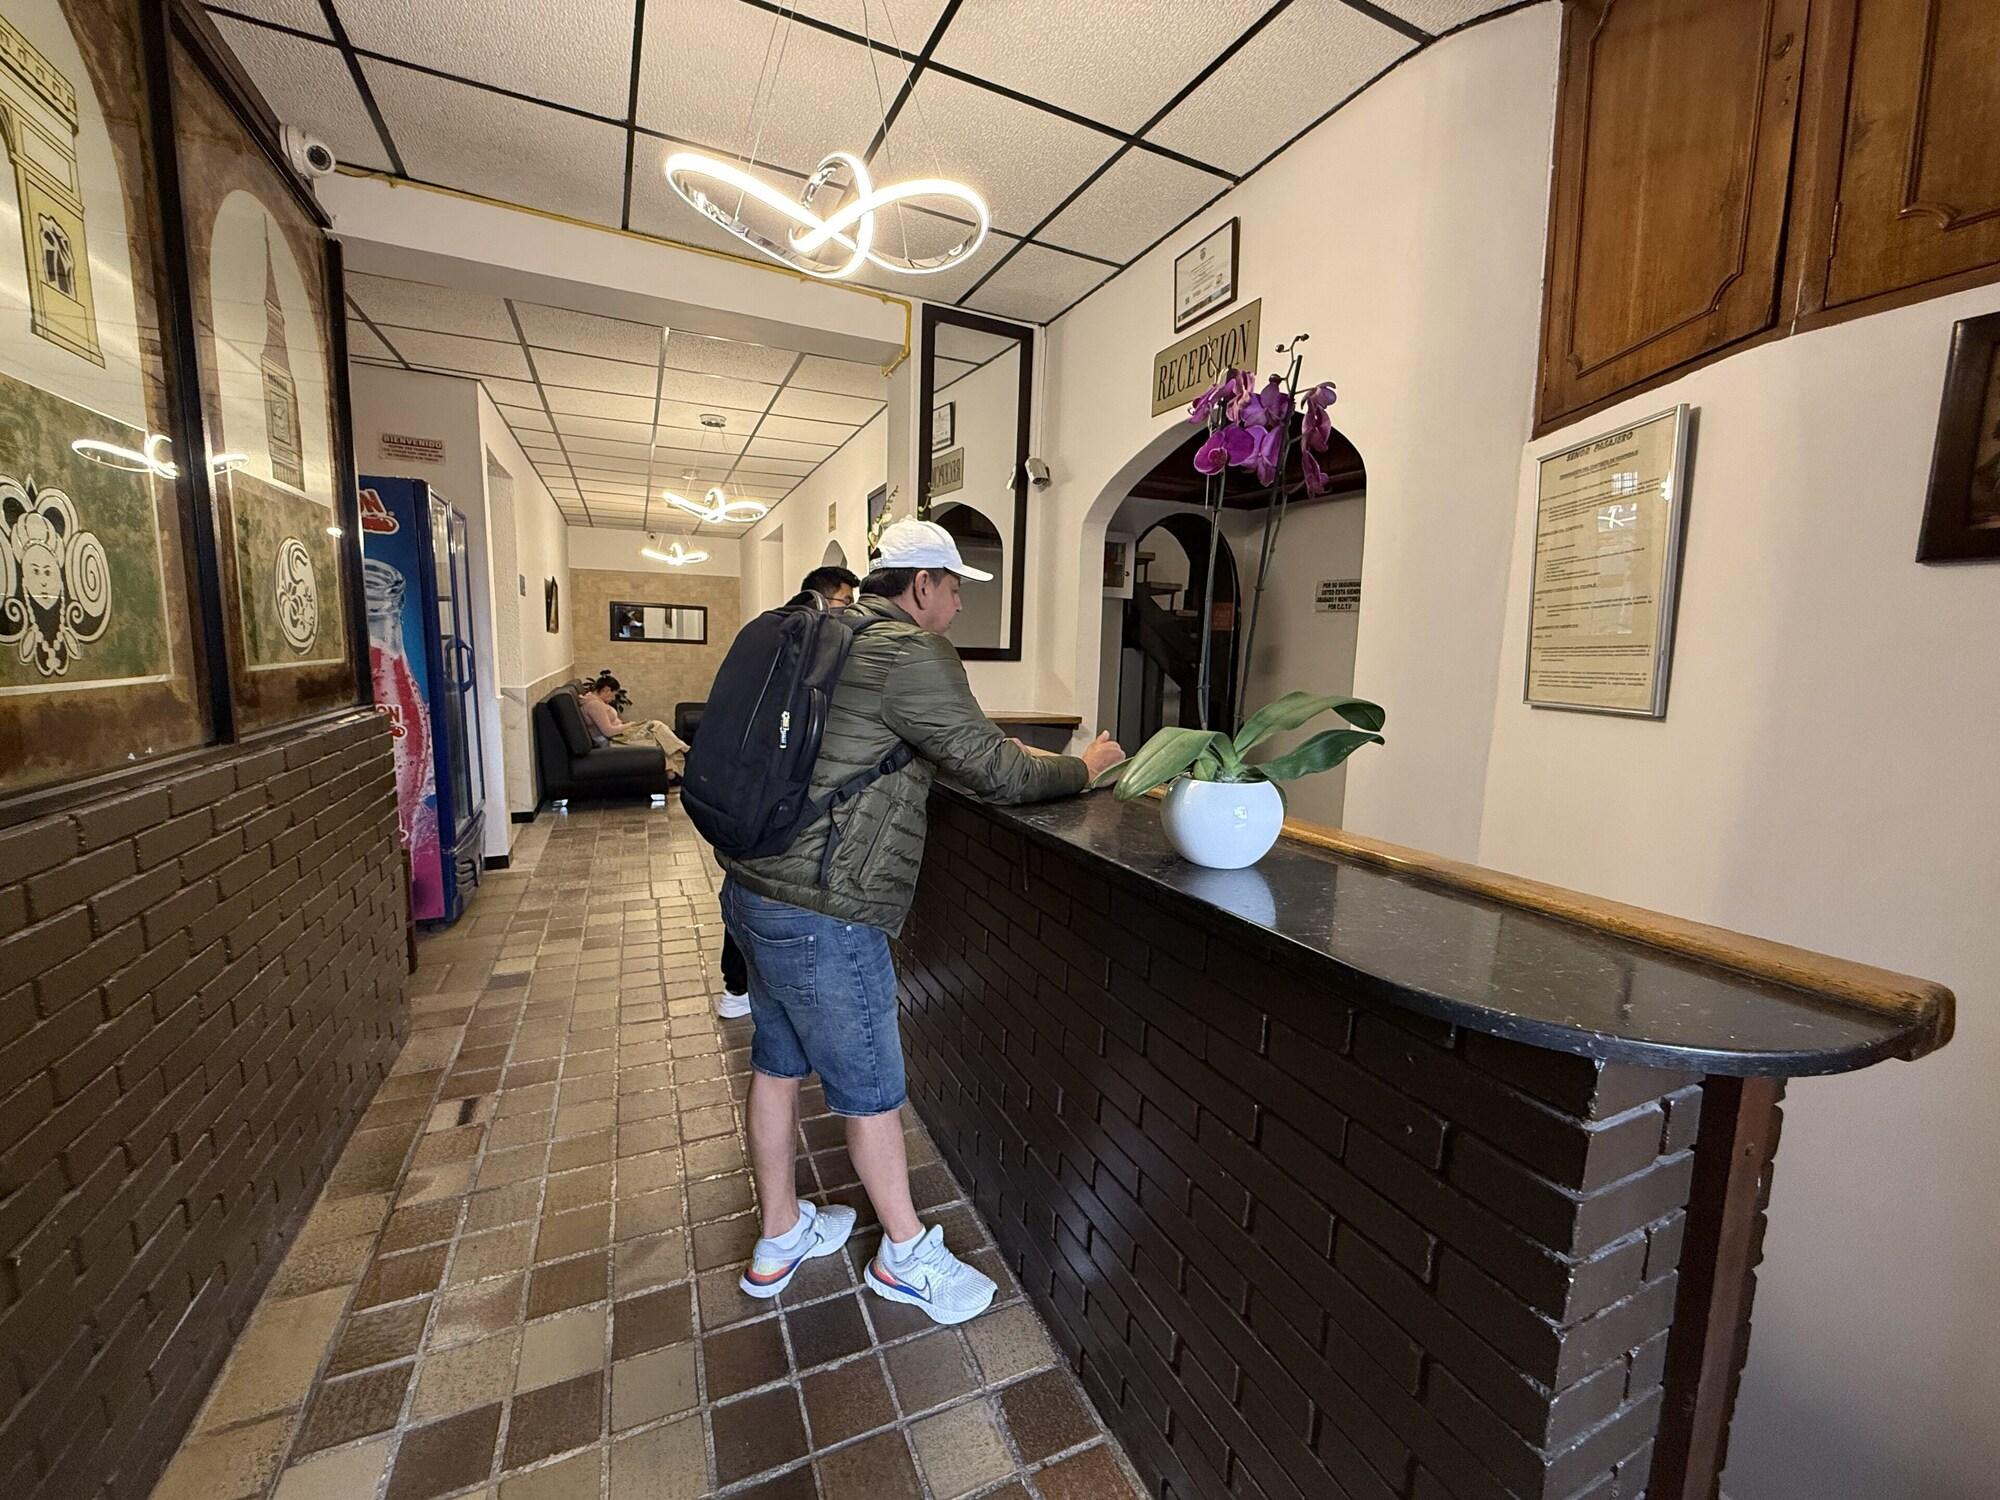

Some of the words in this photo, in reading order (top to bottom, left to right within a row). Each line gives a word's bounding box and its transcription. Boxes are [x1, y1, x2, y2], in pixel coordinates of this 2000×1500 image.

[1157, 320, 1252, 401] RECEPCION
[383, 434, 442, 449] BIENVENIDO
[1593, 431, 1633, 453] PASAJERO
